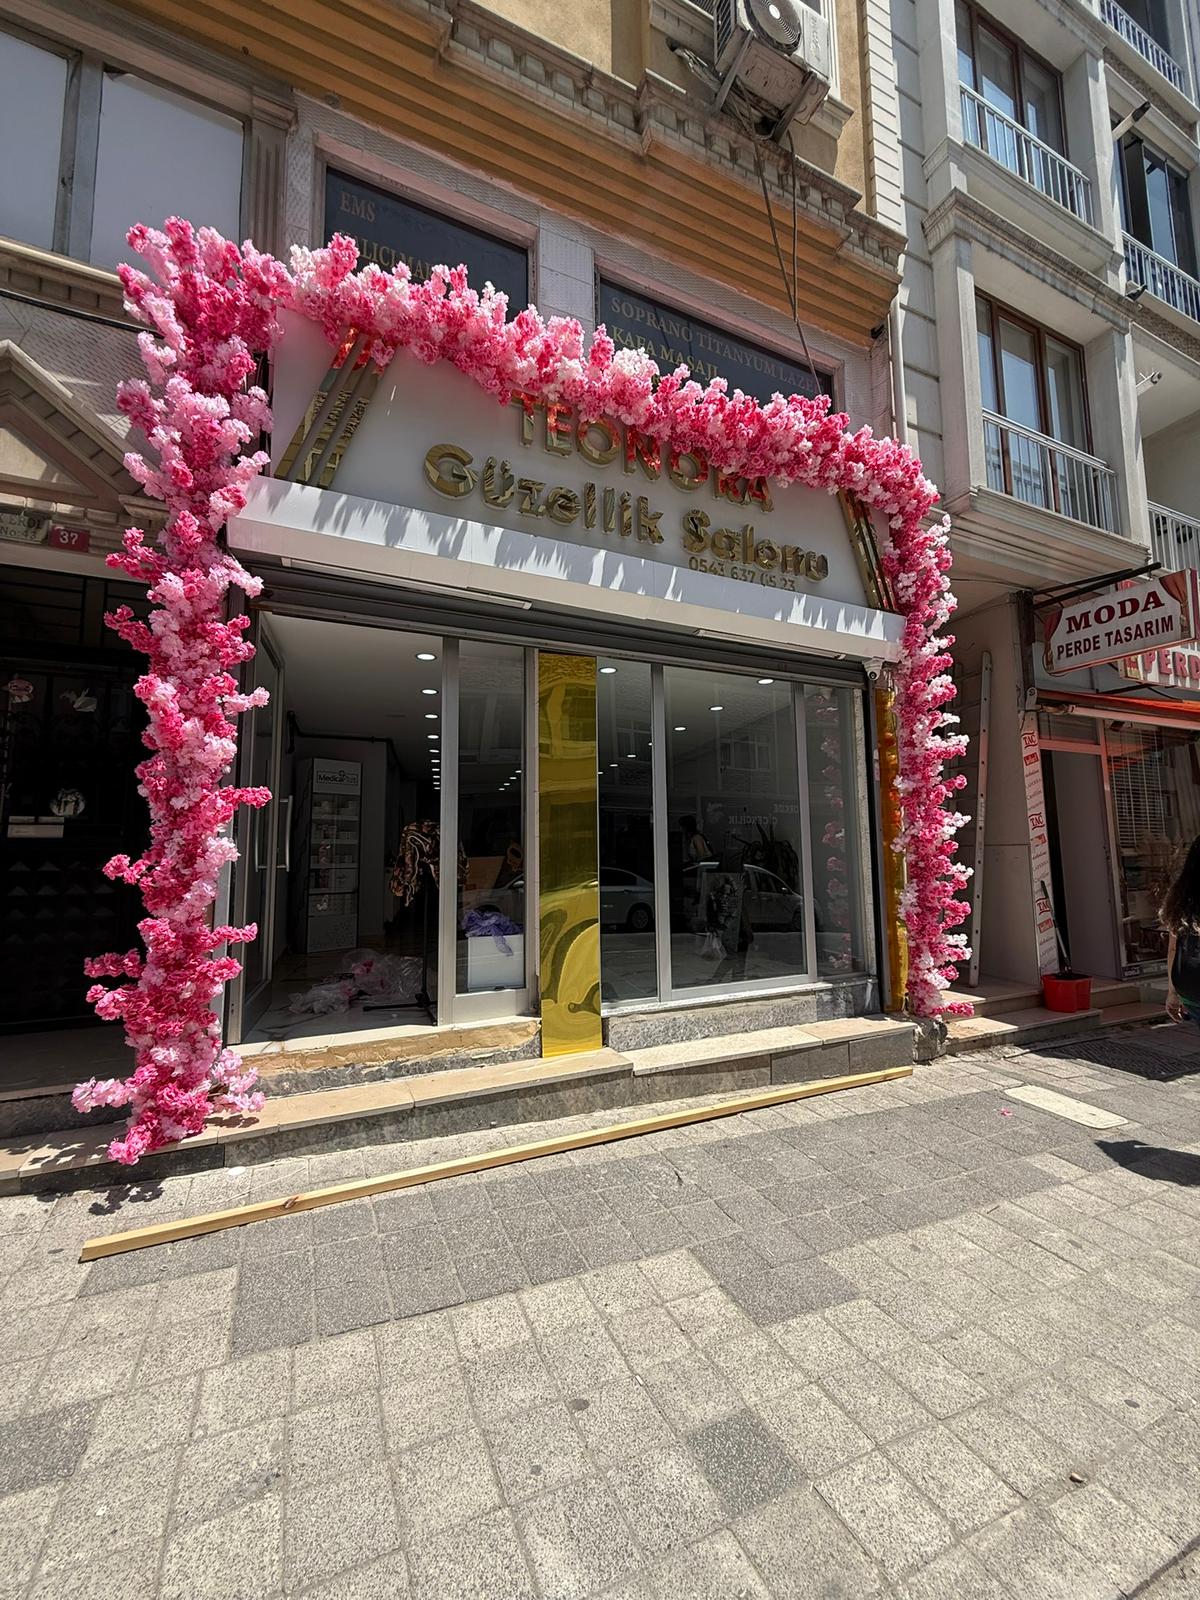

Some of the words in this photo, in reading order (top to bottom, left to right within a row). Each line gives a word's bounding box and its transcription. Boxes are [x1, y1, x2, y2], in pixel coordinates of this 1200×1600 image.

[339, 191, 377, 223] EMS
[611, 296, 693, 342] SOPRANO
[697, 328, 778, 379] TİTANYUM
[611, 325, 657, 357] KAFA
[423, 443, 665, 545] Güzellik
[680, 508, 830, 582] Salonu
[59, 531, 79, 545] 37
[730, 566, 756, 583] 637
[1065, 590, 1165, 634] MODA
[1057, 635, 1100, 661] PERDE
[1105, 614, 1174, 647] TASARIM
